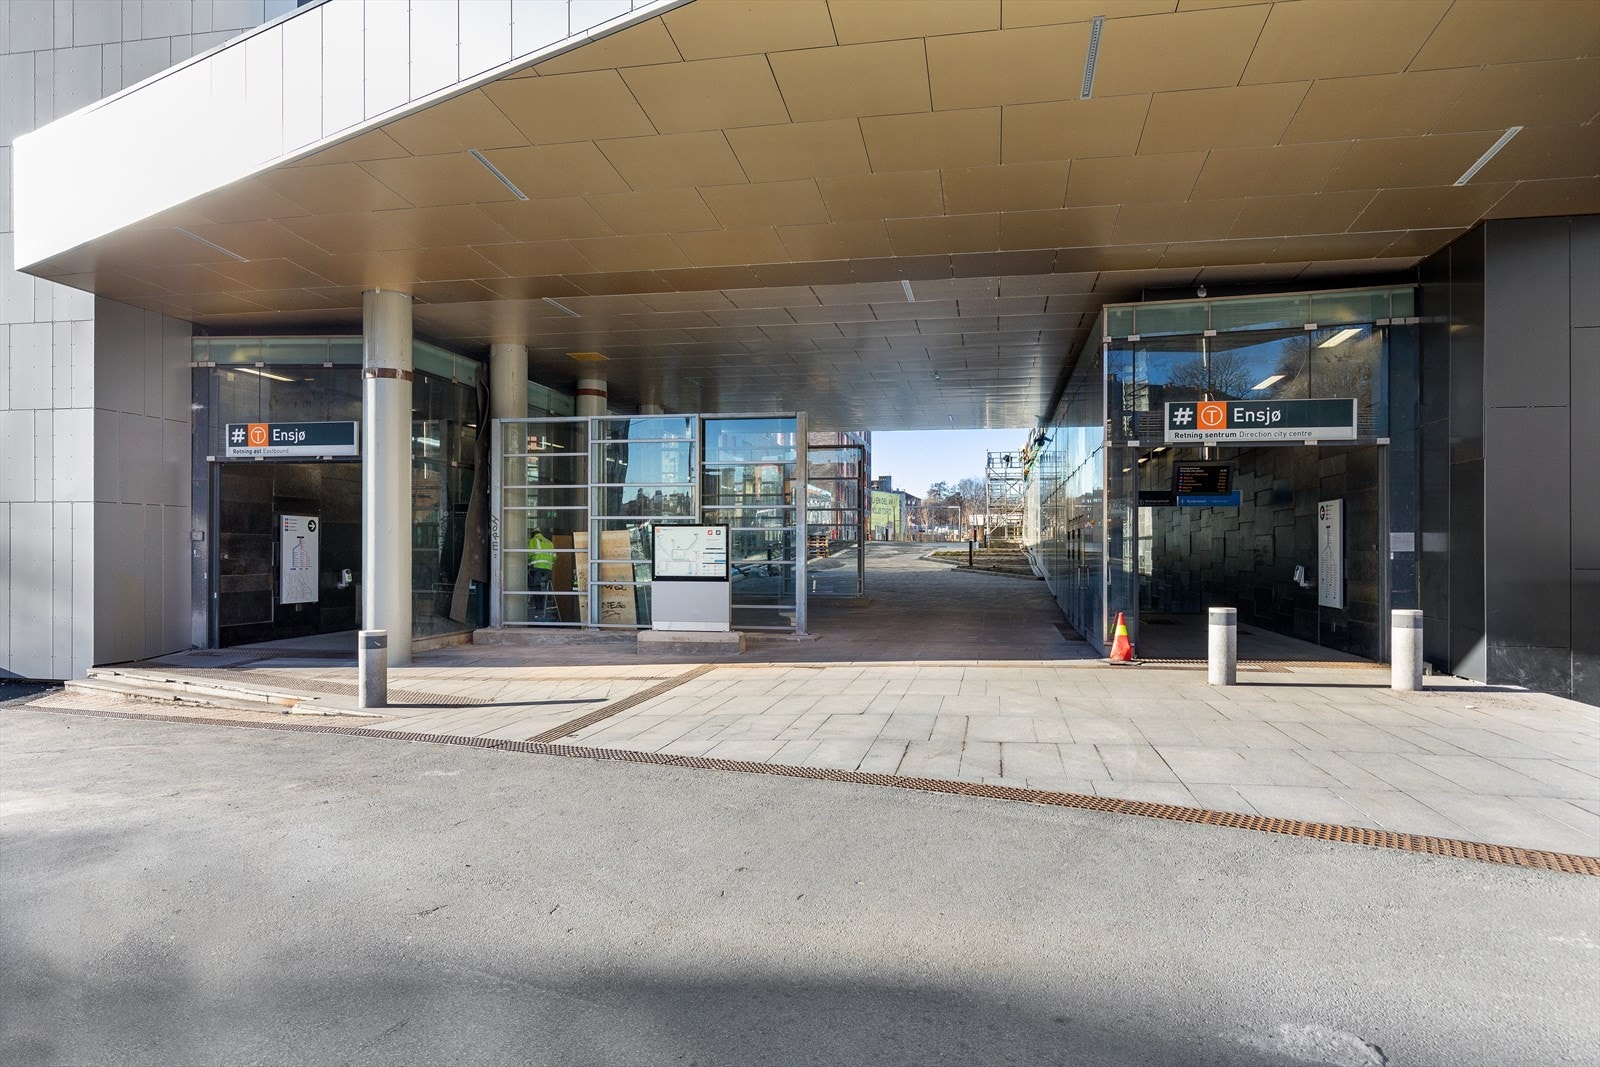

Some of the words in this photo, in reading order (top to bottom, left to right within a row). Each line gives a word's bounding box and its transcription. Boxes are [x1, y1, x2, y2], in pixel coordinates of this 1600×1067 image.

[1233, 407, 1281, 425] Ensjø
[272, 428, 306, 444] Ensjø
[1174, 432, 1203, 440] Retning
[1204, 431, 1237, 439] sentrum
[1239, 430, 1272, 438] Direction
[1273, 430, 1287, 438] city
[232, 448, 253, 456] Retning
[262, 447, 289, 455] Eastbound
